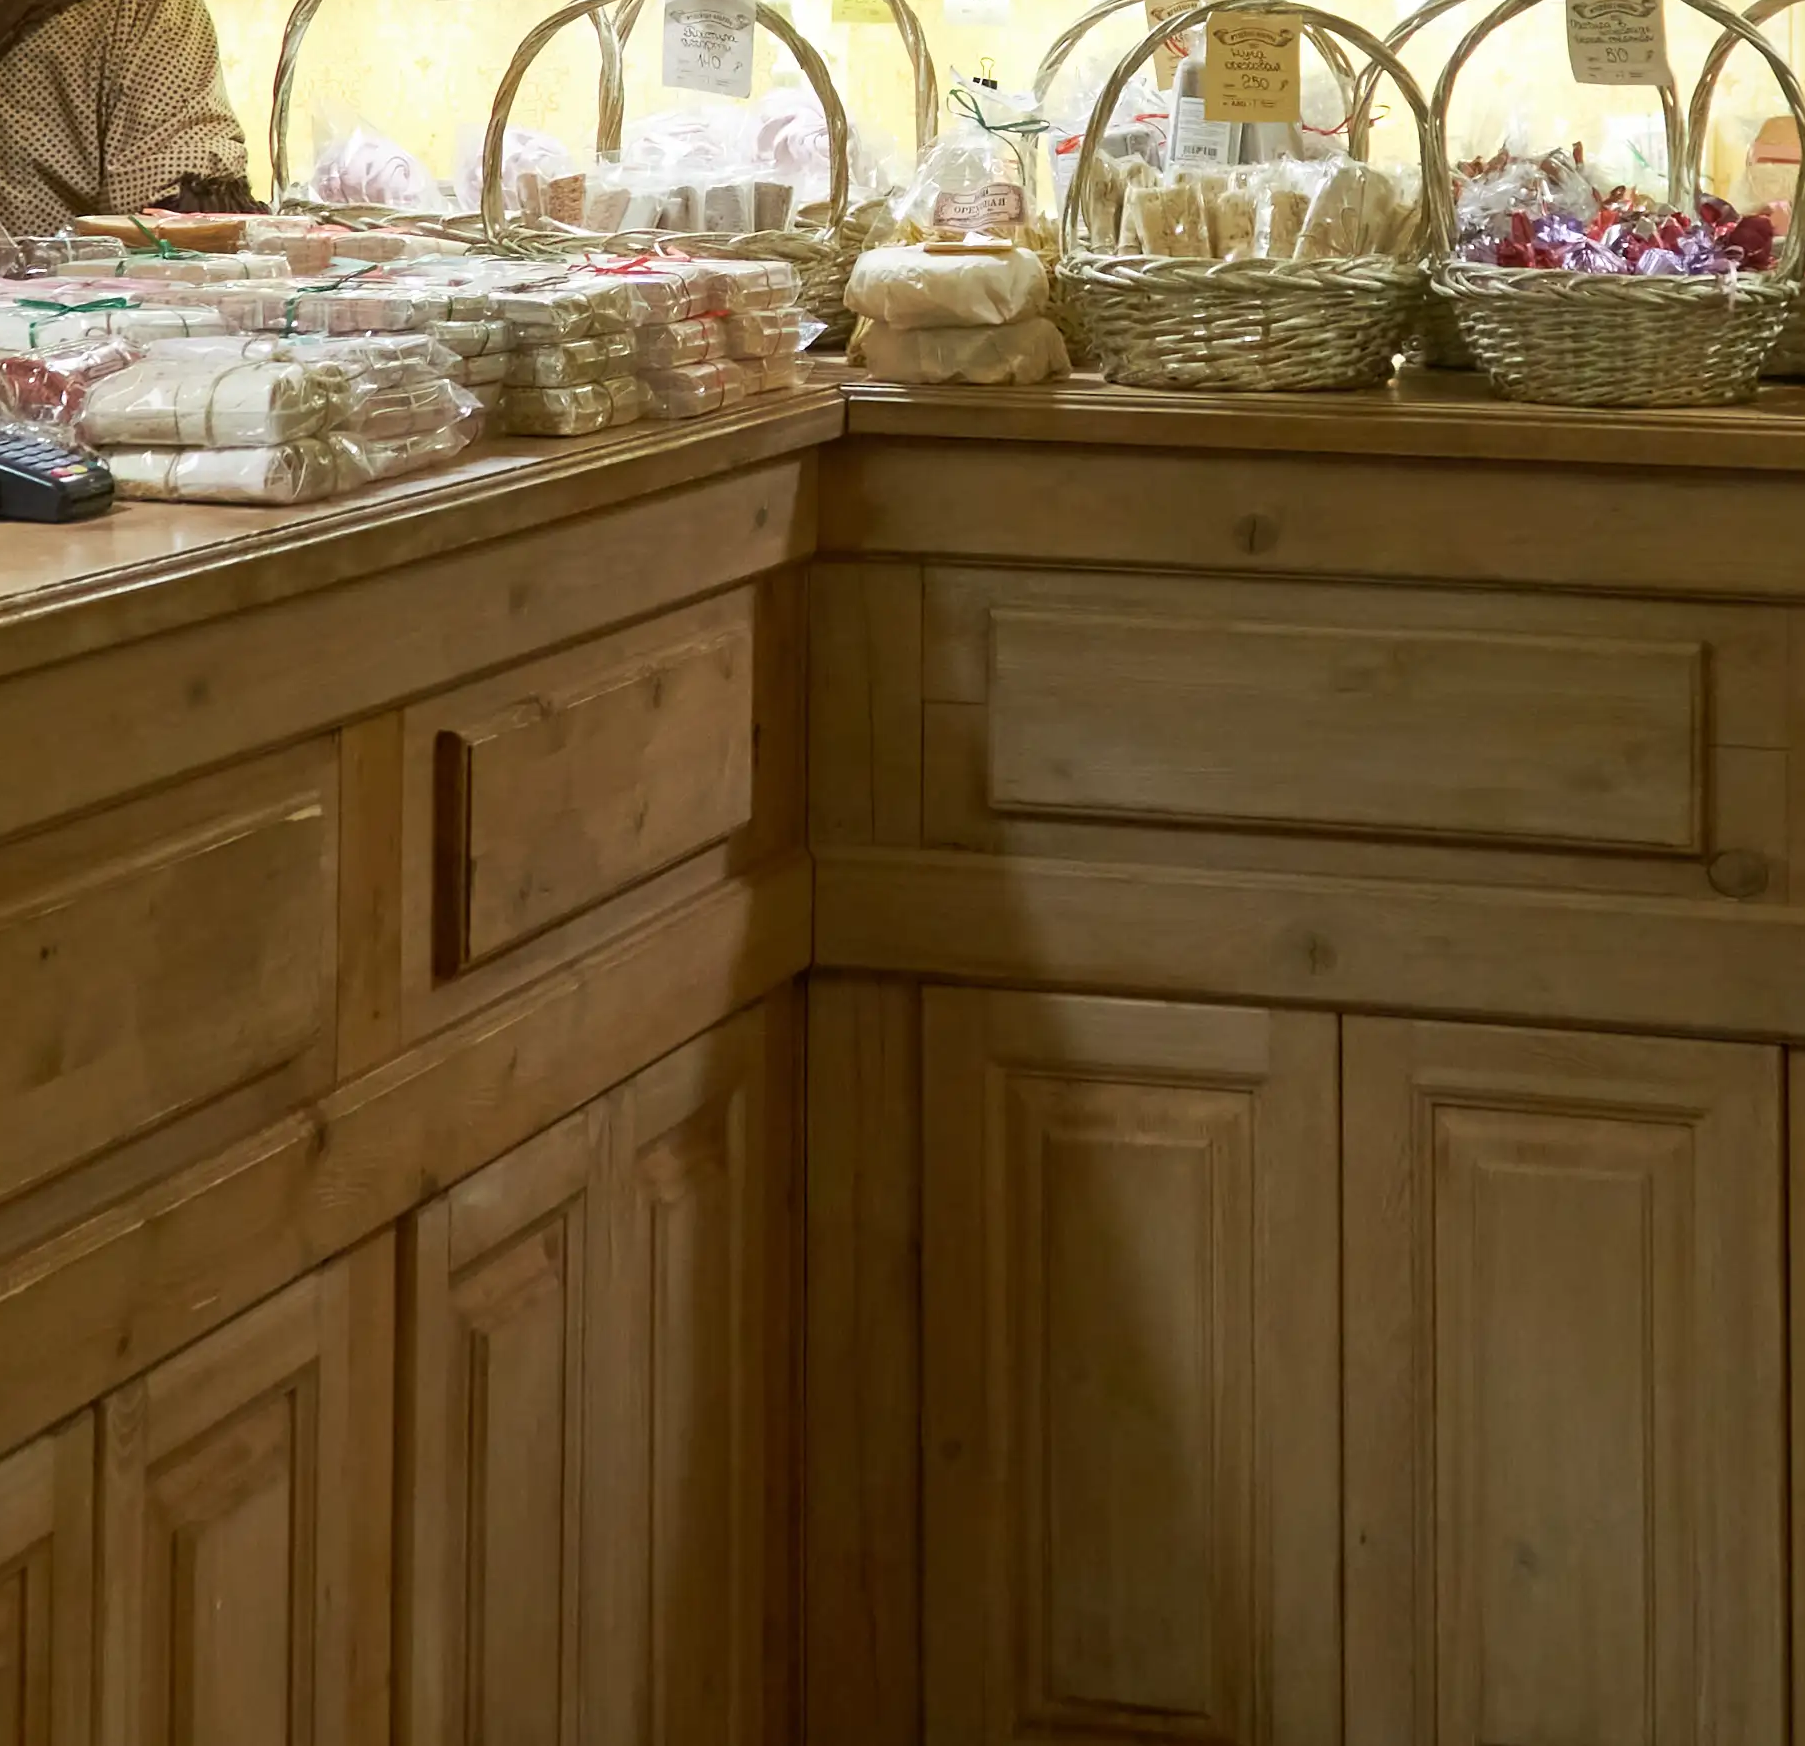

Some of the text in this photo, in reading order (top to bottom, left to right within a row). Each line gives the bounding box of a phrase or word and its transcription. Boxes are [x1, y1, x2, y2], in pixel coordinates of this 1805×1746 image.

[697, 53, 721, 70] 140
[1241, 73, 1270, 91] 250
[953, 197, 1006, 215] ОРЕХВАЯ
